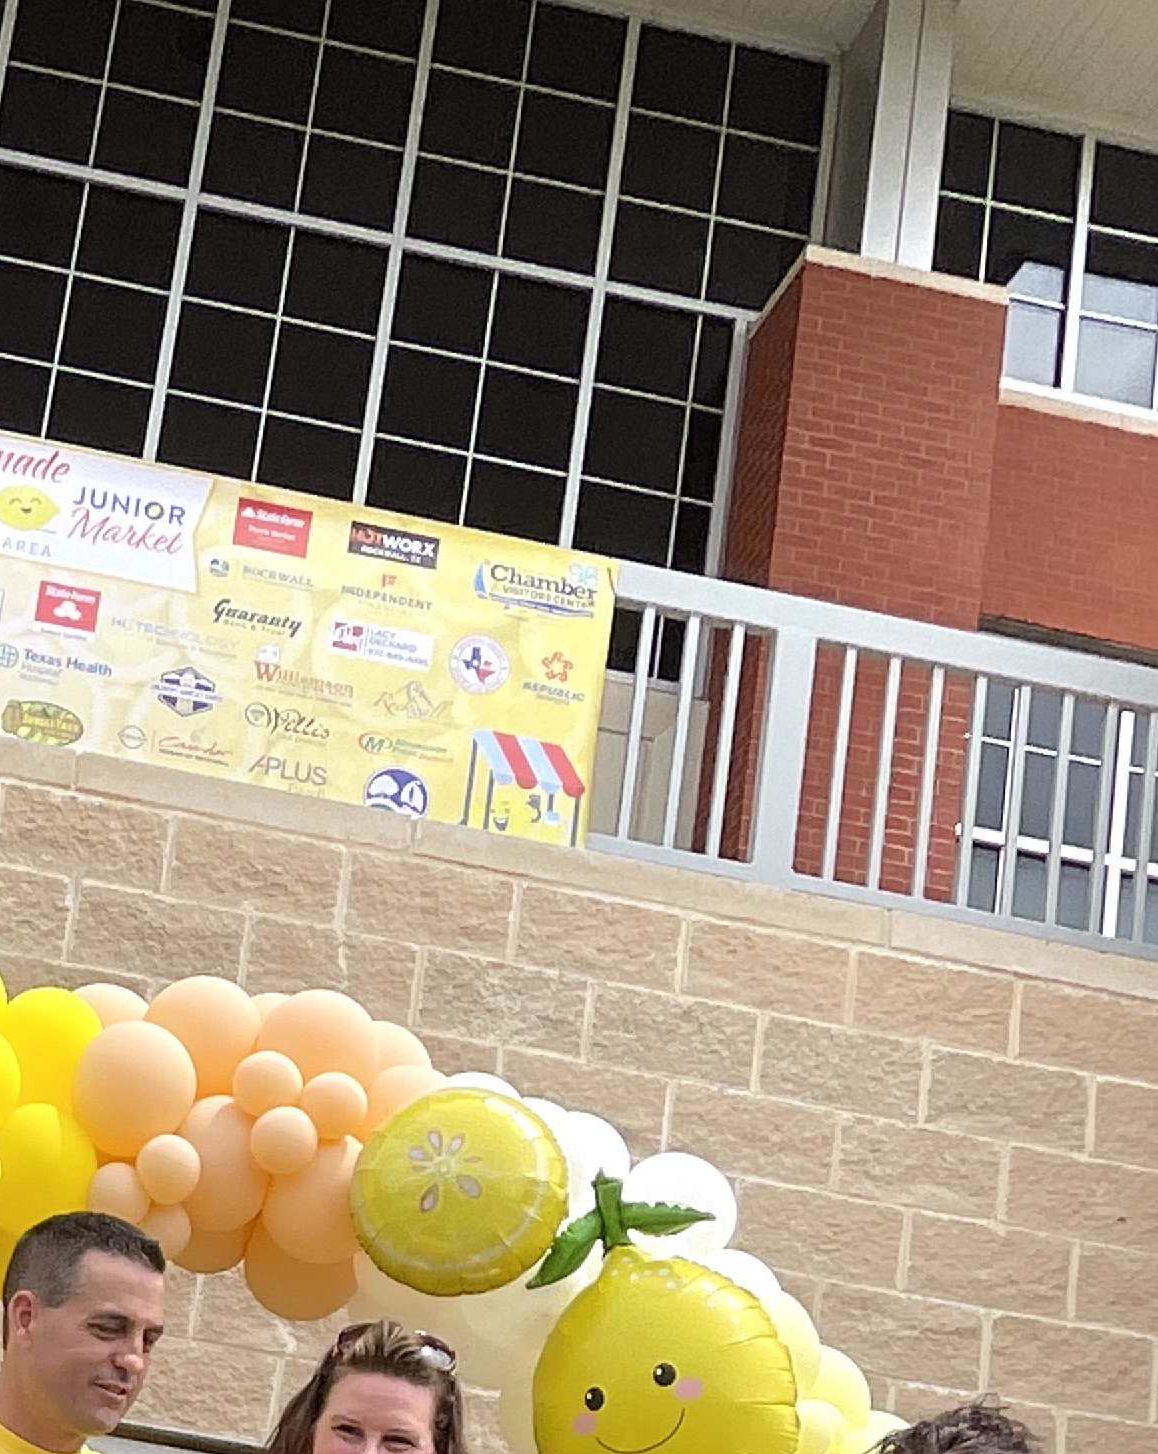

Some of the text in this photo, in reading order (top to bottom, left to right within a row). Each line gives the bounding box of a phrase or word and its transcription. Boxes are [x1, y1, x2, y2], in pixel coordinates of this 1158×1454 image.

[73, 486, 185, 526] JUNIOR
[67, 506, 183, 555] Market
[352, 527, 435, 557] HOTWORX
[2, 537, 53, 558] AREA
[490, 564, 597, 599] Chamber
[213, 598, 303, 638] Guaranty
[24, 648, 112, 677] Texas Health
[522, 681, 585, 702] REPUBLIC
